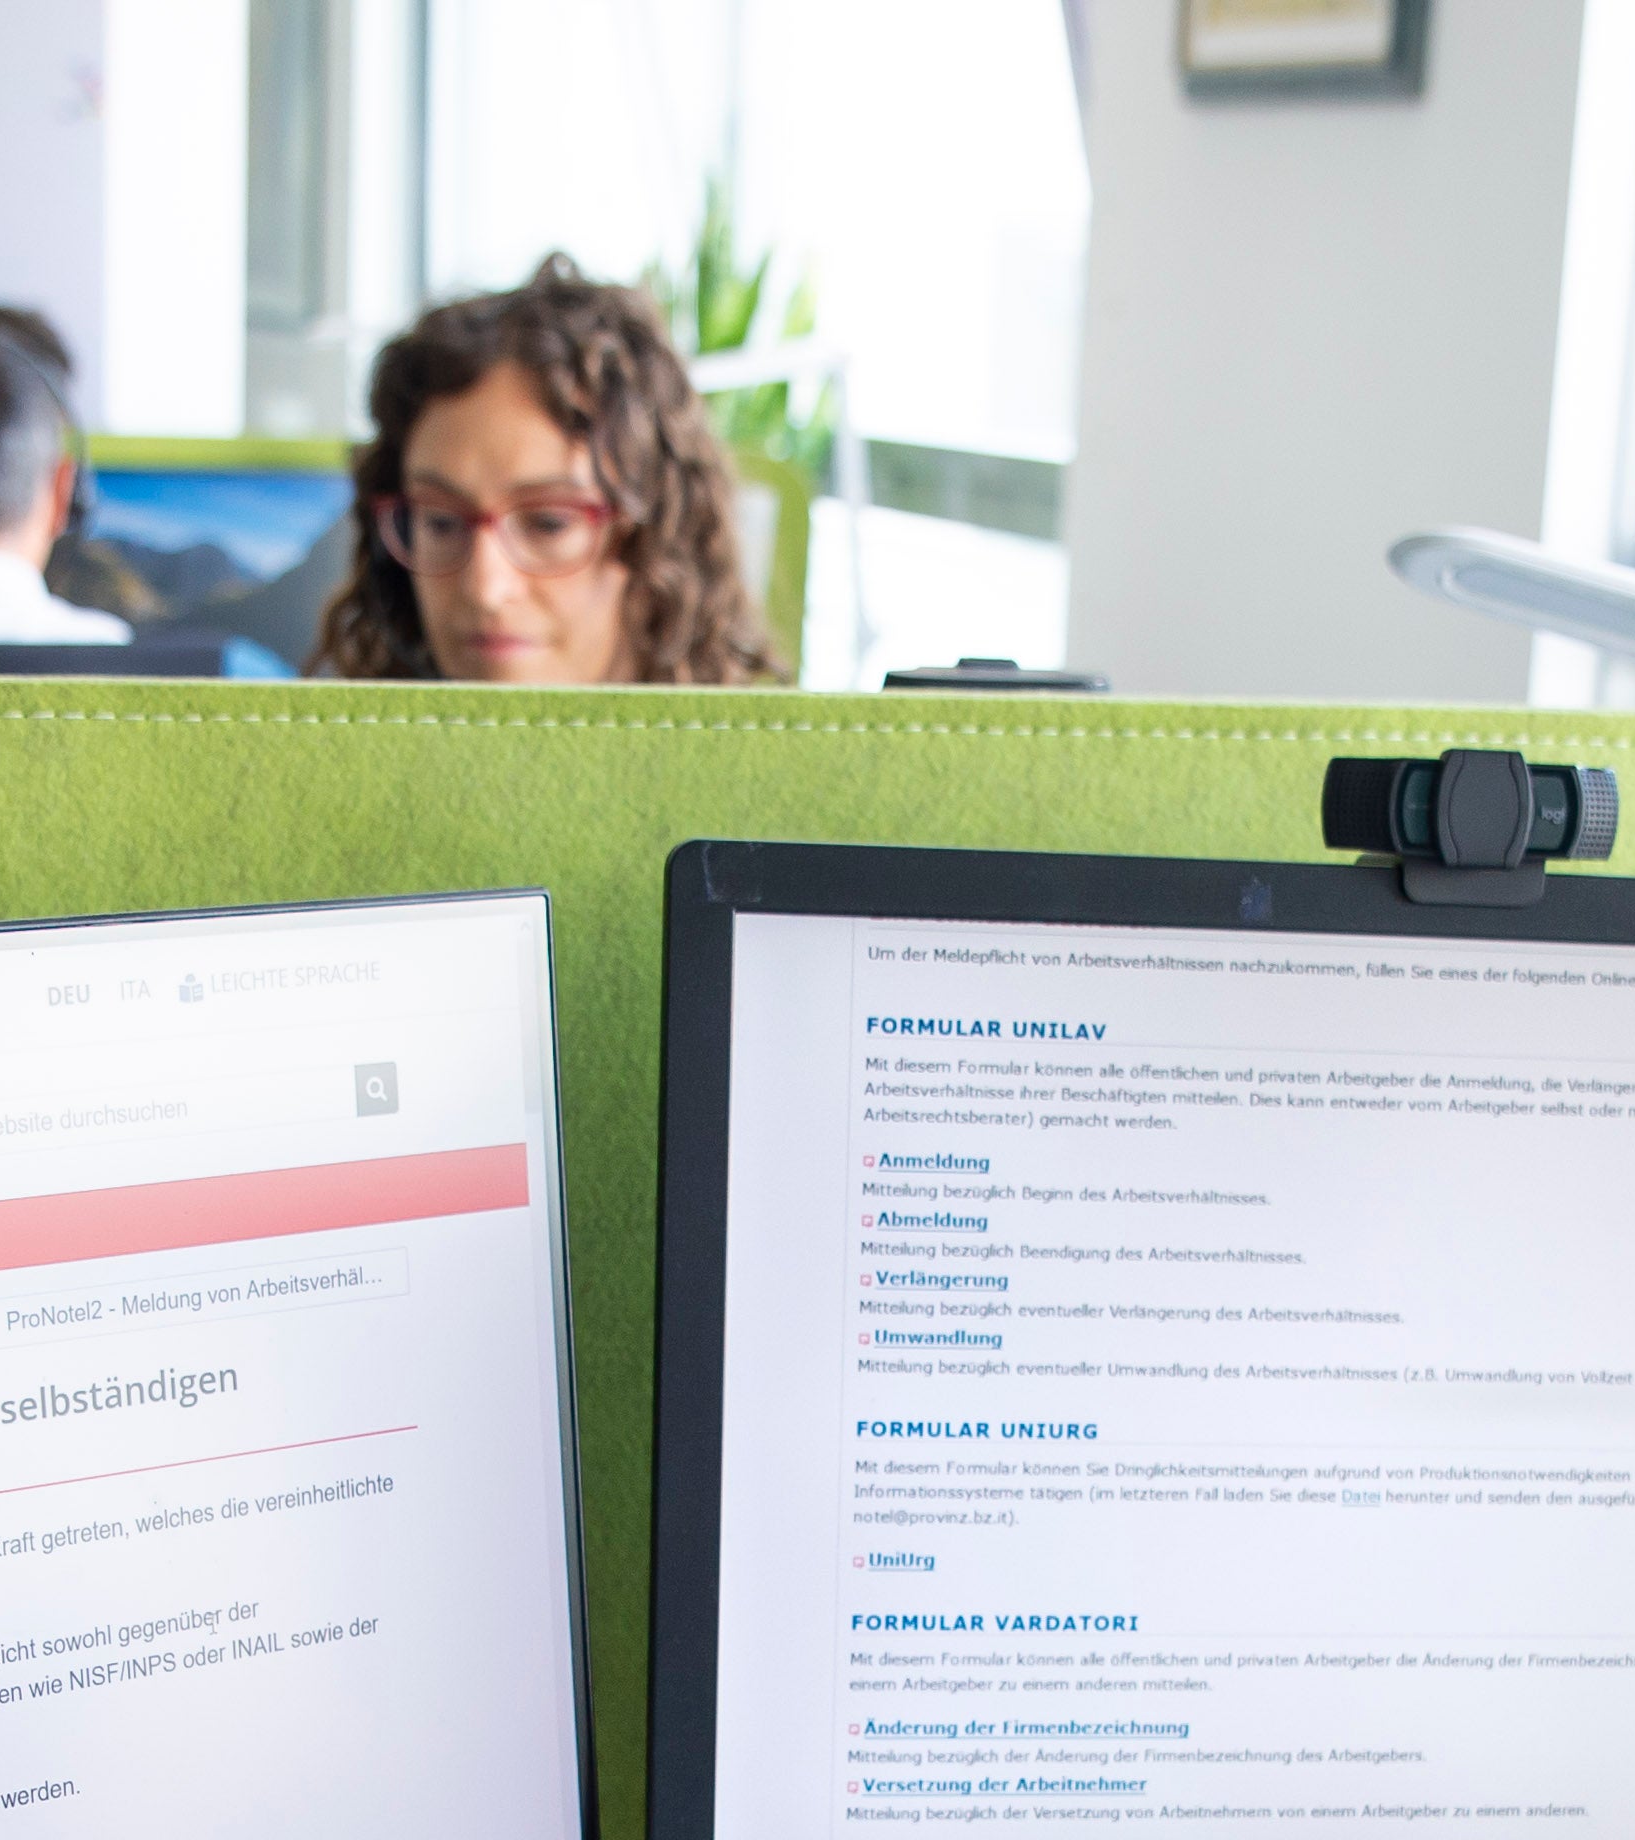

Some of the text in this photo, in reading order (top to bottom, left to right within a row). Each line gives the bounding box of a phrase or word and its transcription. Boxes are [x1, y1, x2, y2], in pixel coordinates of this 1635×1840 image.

[210, 960, 380, 994] LEICHTE SPRACHE
[47, 983, 90, 1007] DEU
[120, 979, 151, 1001] ITA
[867, 1017, 1106, 1041] FORMULAR UNILAV
[59, 1099, 188, 1130] durchsuchen
[879, 1152, 990, 1172] Anmeldung
[877, 1211, 988, 1231] Abmeldung
[876, 1270, 1008, 1290] Verlängerung
[6, 1299, 103, 1331] ProNotel2
[122, 1290, 202, 1316] Meldung
[207, 1287, 241, 1304] von
[875, 1329, 1002, 1349] Umwandlung
[0, 1367, 238, 1425] selbständigen
[857, 1421, 1097, 1440] FORMULAR UNIURG
[41, 1521, 129, 1555] getreten,
[135, 1506, 214, 1534] welches
[221, 1497, 249, 1519] die
[254, 1474, 394, 1513] vereinheitlichte
[869, 1552, 935, 1570] UniUrg
[42, 1624, 112, 1657] sowohl
[118, 1609, 222, 1648] gegenüber
[228, 1601, 259, 1622] der
[852, 1614, 1138, 1632] FORMULAR VARDATORI
[864, 1718, 1189, 1737] Änderung der Firmenbezeichnung
[0, 1780, 80, 1809] werden.
[863, 1776, 1147, 1794] Versetzung der Arbeitnehmer
